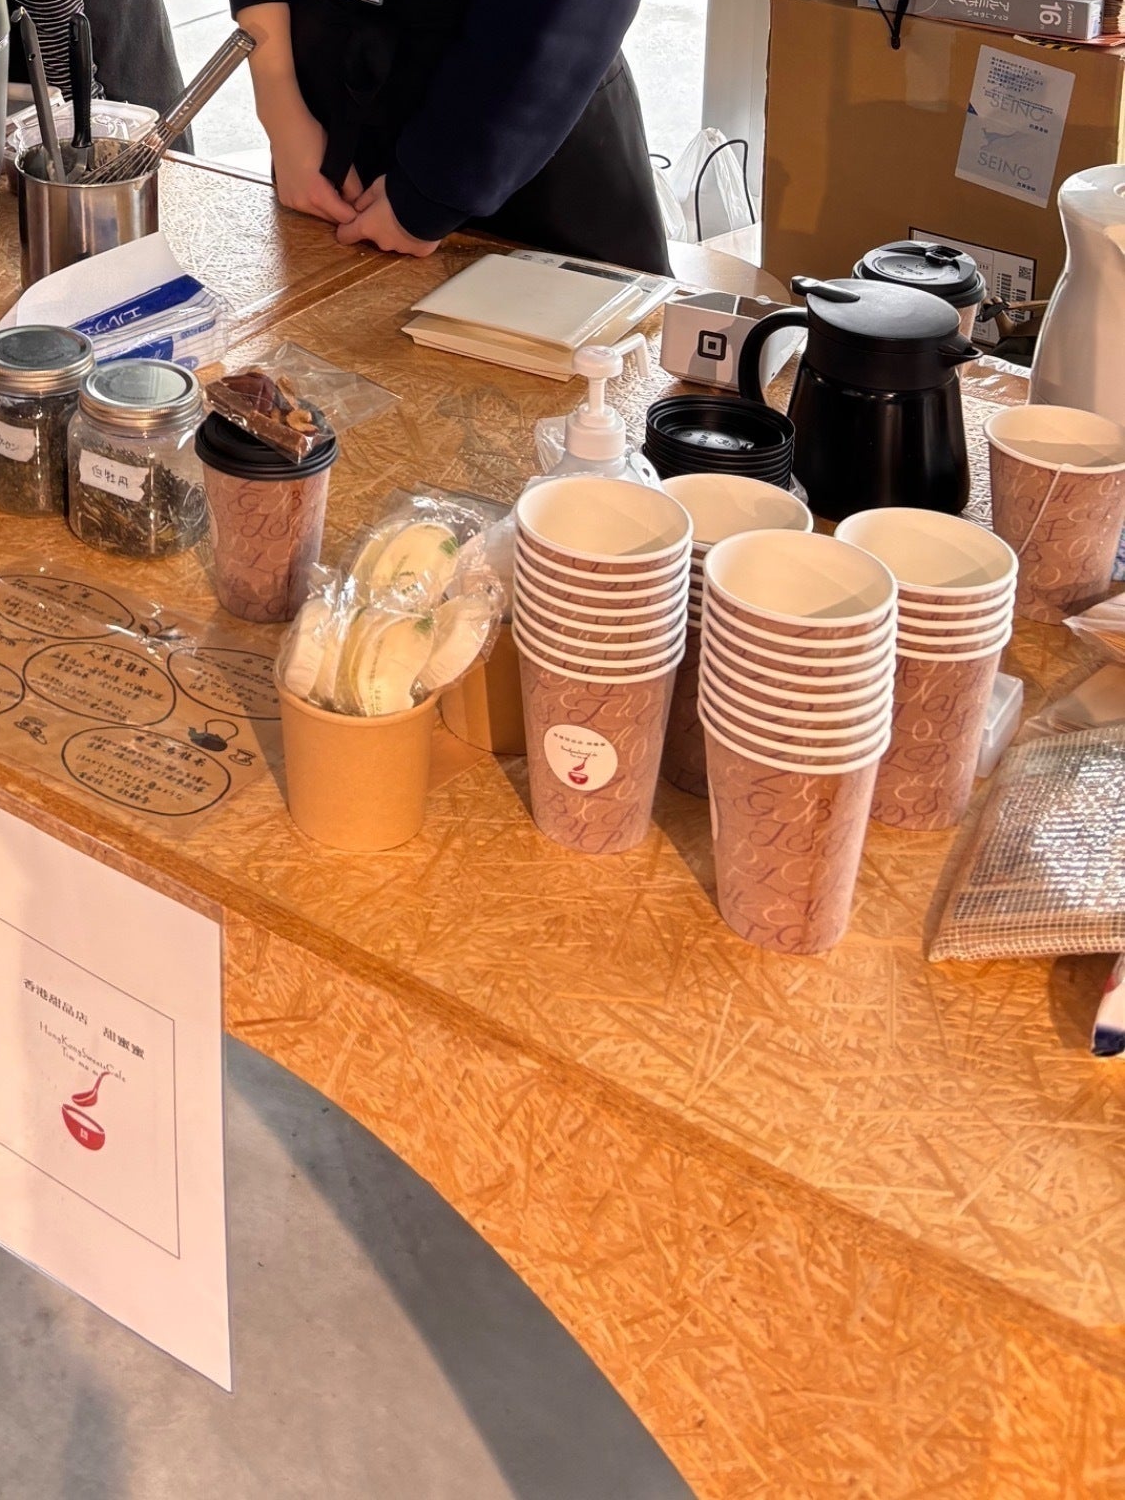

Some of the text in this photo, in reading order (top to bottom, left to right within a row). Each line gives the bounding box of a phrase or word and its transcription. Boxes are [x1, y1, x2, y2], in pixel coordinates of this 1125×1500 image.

[977, 151, 1033, 181] SEINO
[91, 464, 129, 489] 白牡丹
[22, 978, 146, 1061] 香港甜品店 甜蜜蜜
